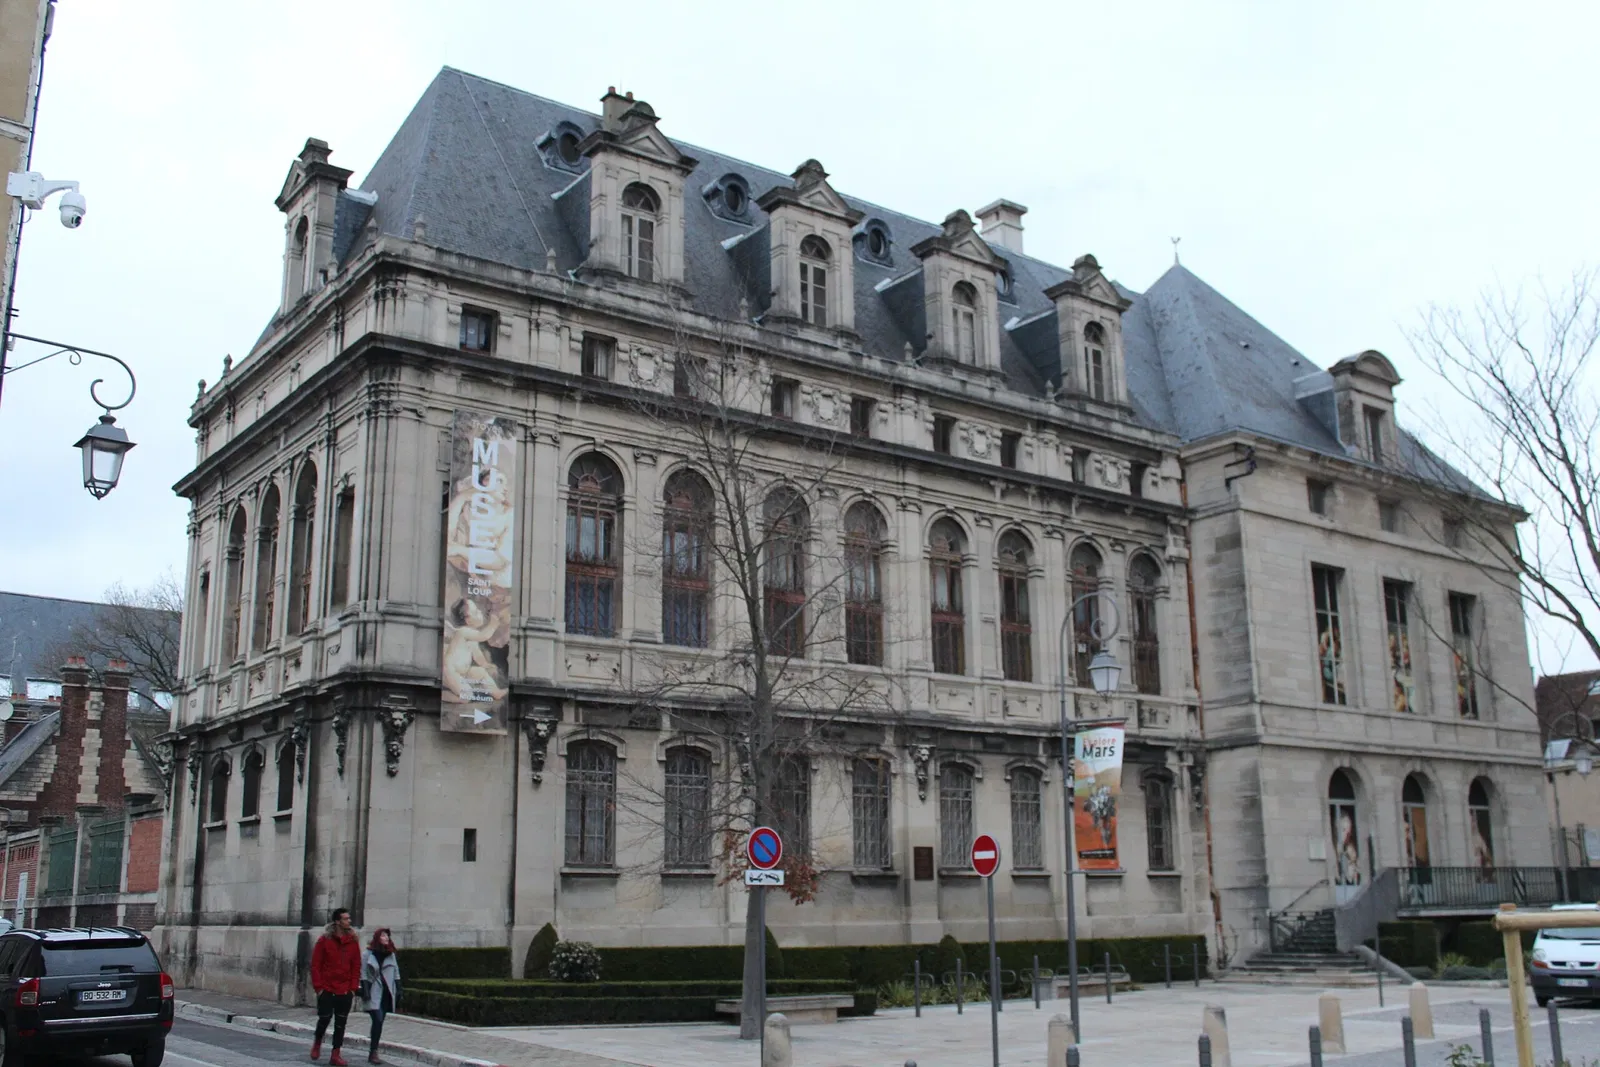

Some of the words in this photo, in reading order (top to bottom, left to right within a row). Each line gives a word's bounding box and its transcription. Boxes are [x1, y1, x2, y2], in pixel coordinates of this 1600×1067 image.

[467, 577, 491, 587] SAINT
[467, 587, 492, 596] LOUP
[1082, 745, 1115, 759] Mars
